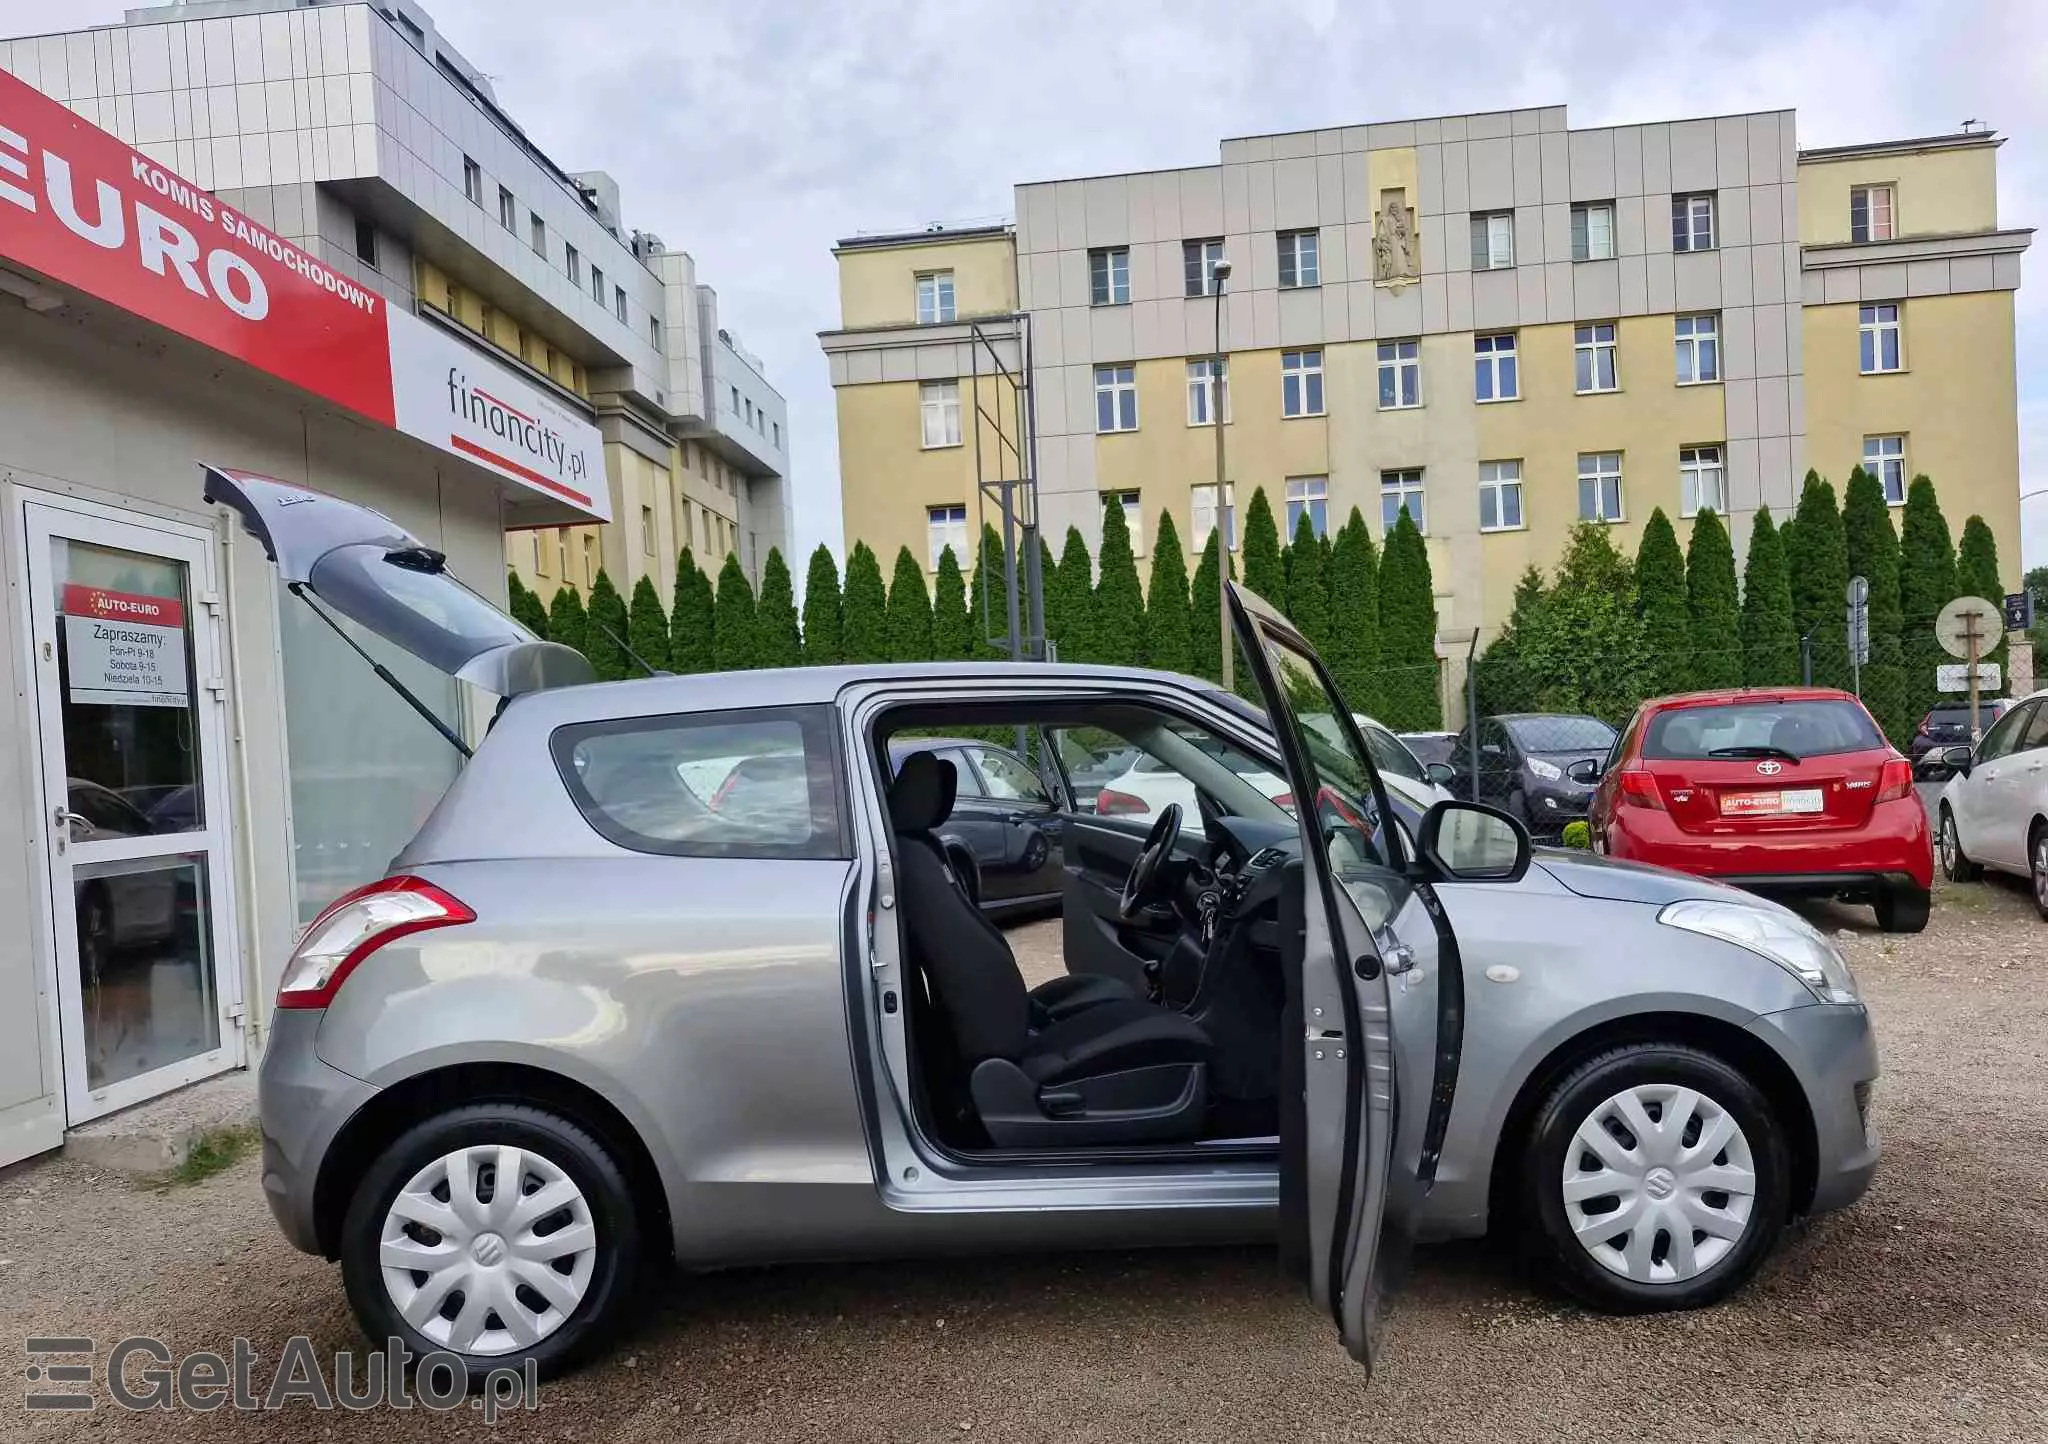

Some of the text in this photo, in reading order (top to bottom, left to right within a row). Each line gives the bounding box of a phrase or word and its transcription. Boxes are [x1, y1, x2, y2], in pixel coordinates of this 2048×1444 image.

[131, 155, 374, 314] KOMIS SAMOCHODOWY
[447, 367, 587, 481] financity.pl
[97, 598, 160, 616] AUTO-EURO
[94, 624, 166, 649] Zapraszamy:
[110, 660, 137, 671] Sobota
[104, 672, 140, 685] Niedziela
